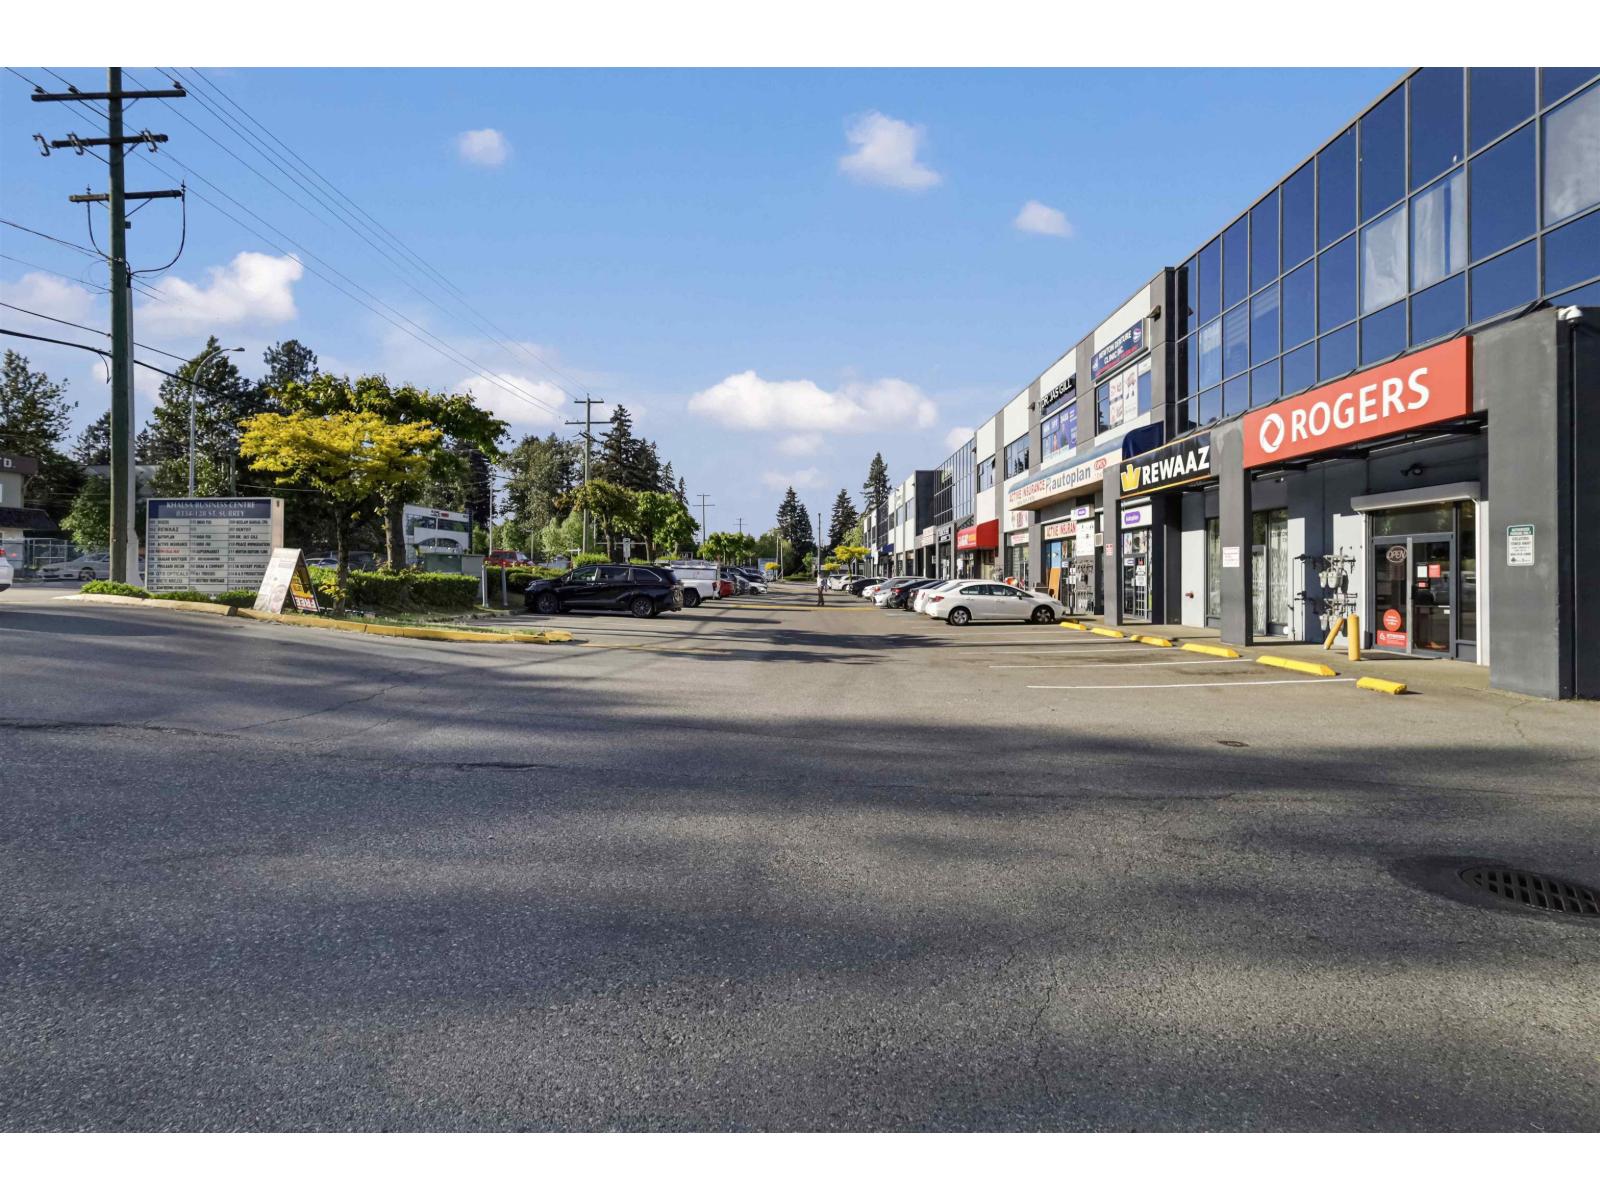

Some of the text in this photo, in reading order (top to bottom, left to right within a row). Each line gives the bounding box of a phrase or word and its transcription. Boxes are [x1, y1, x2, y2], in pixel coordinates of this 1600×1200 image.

[1059, 378, 1072, 394] GILL
[1291, 367, 1430, 442] ROGERS
[1142, 446, 1210, 485] REWAAZ
[1022, 479, 1045, 498] INSURANCE
[1052, 467, 1091, 490] autoplan
[1046, 526, 1059, 537] ACTIVE
[1388, 550, 1406, 559] OPEN
